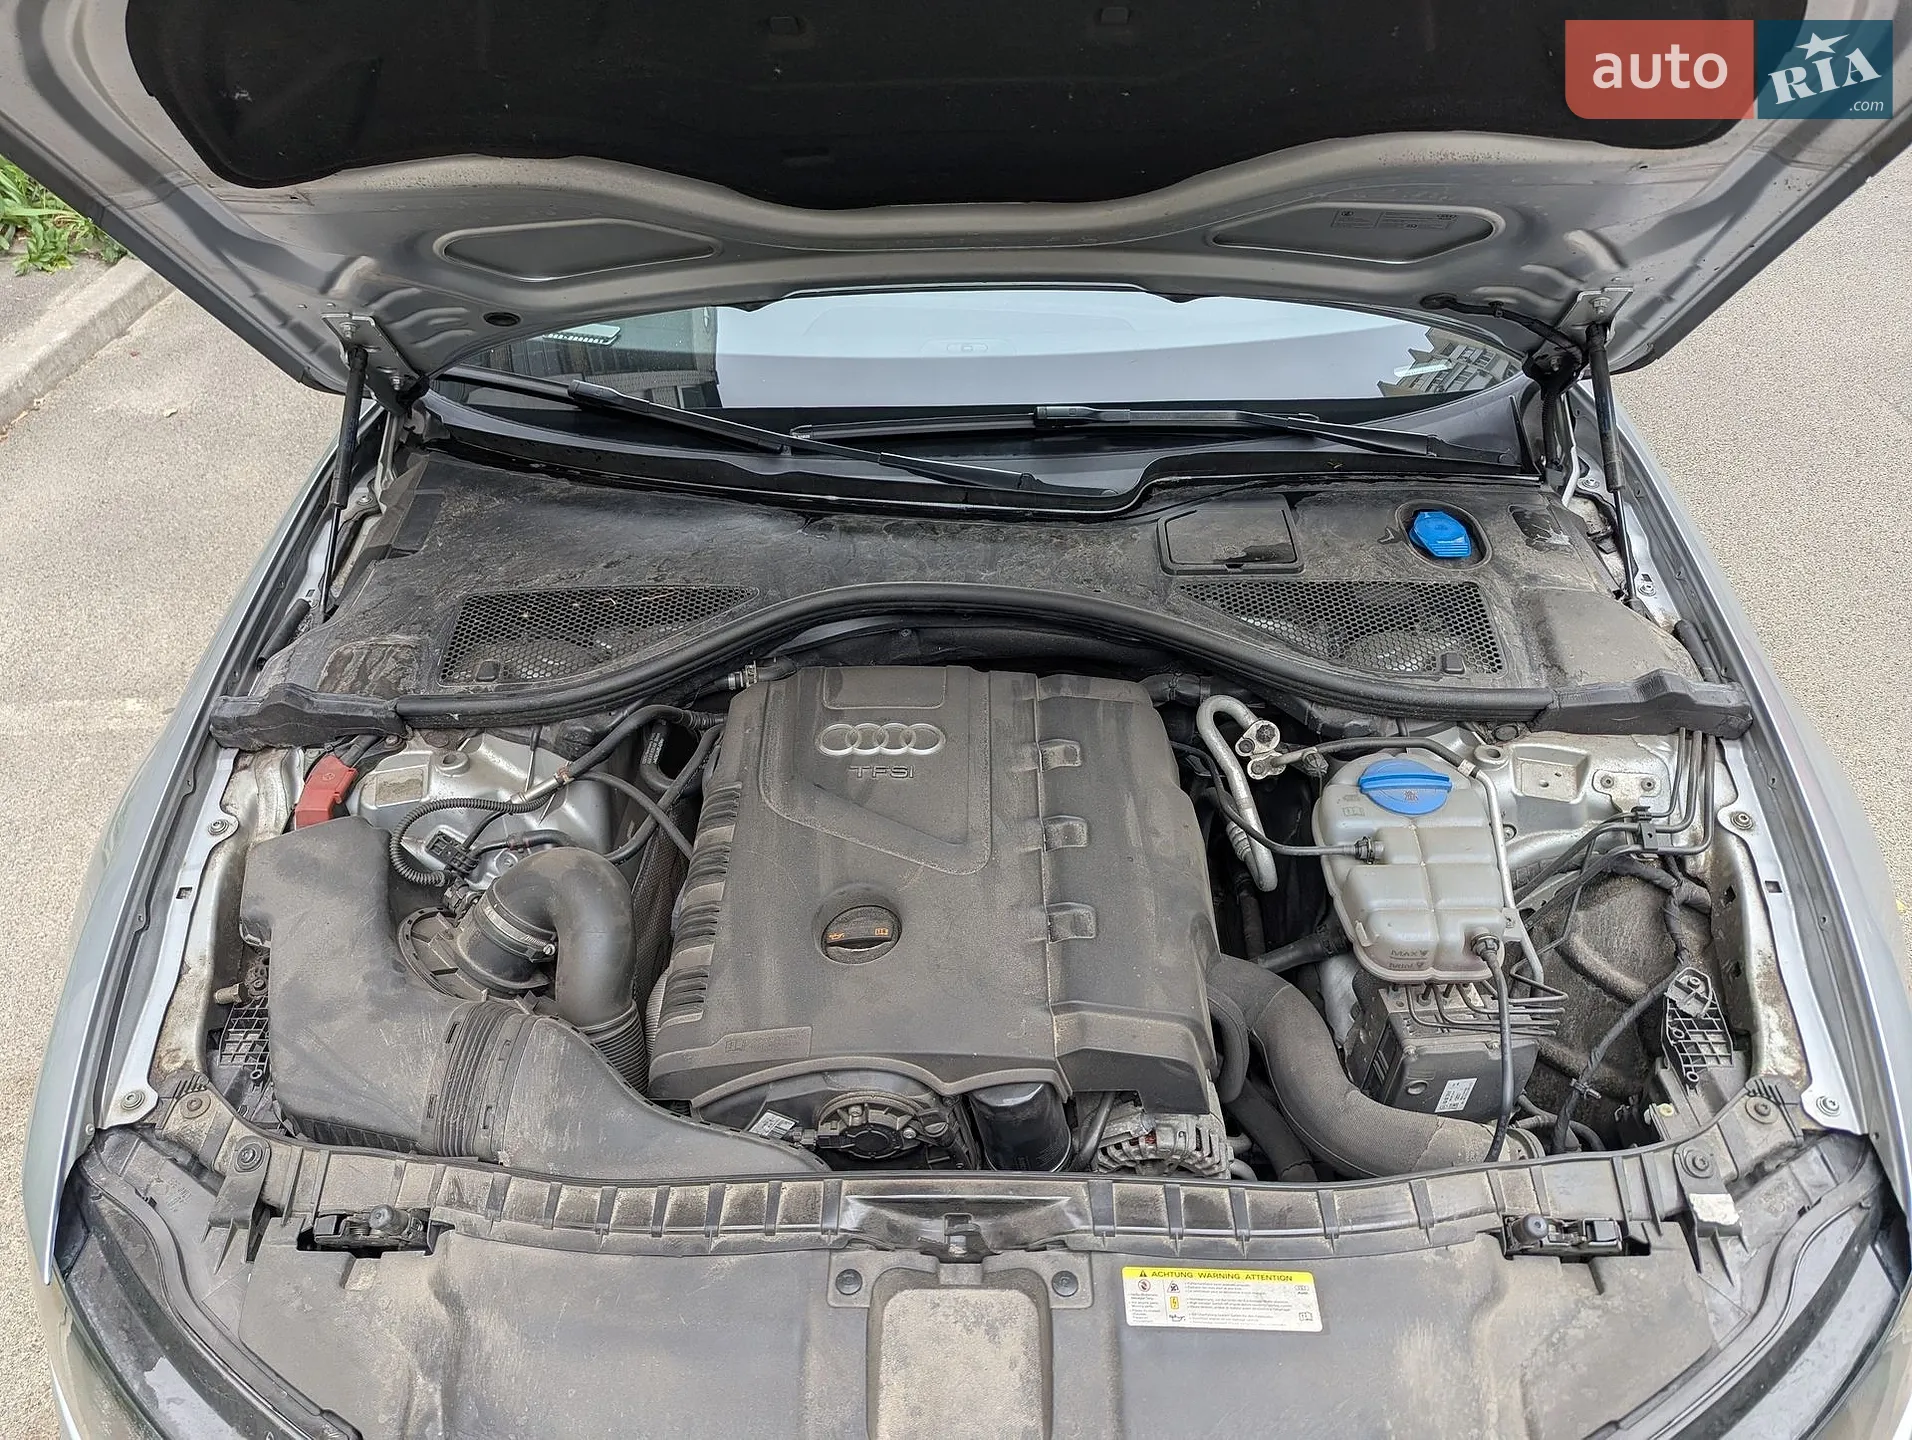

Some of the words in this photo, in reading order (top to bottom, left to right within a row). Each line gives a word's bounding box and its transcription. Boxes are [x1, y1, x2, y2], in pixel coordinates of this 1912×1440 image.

[849, 765, 914, 778] TFSI
[1197, 1272, 1241, 1280] WARNING
[1244, 1273, 1293, 1282] ATTENTION
